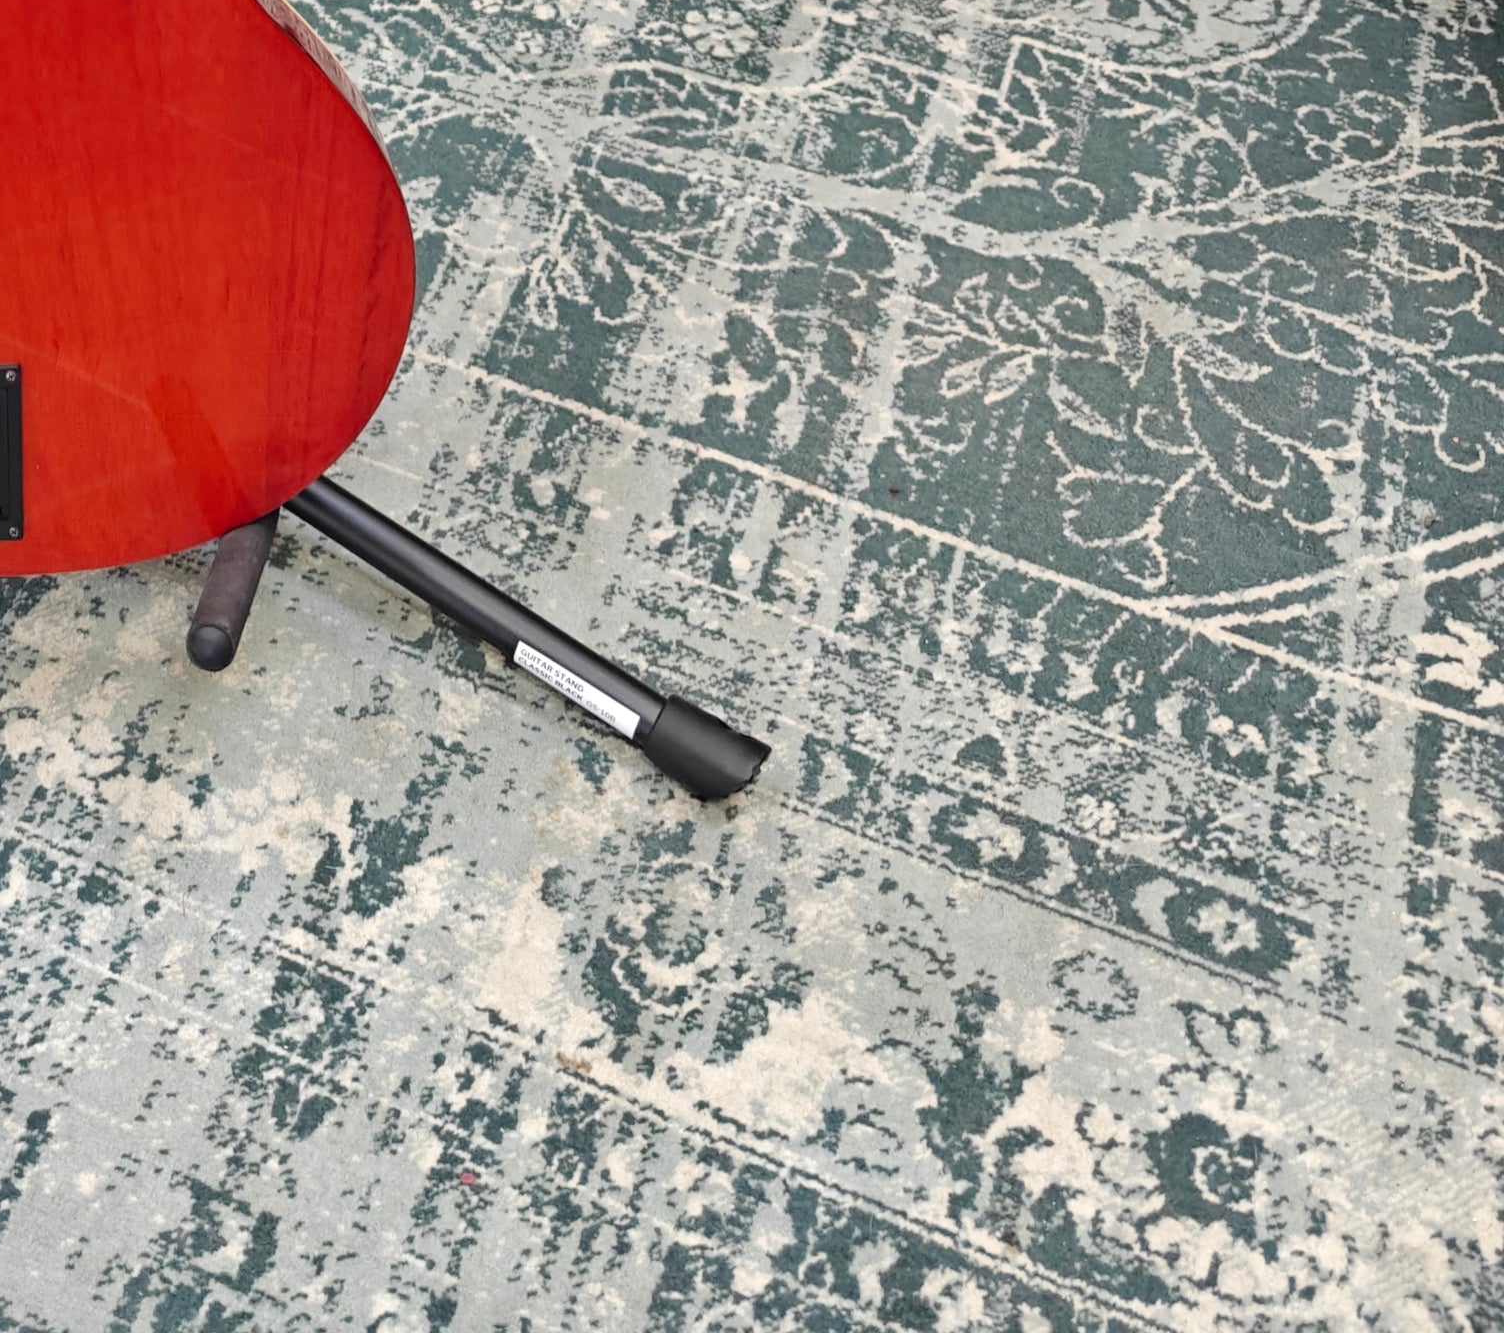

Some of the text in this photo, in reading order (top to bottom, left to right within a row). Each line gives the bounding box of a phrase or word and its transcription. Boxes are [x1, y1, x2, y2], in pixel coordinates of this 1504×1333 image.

[517, 656, 554, 683] CLASSIC
[554, 680, 584, 702] BLACK
[519, 648, 585, 693] GUITAR STAND
